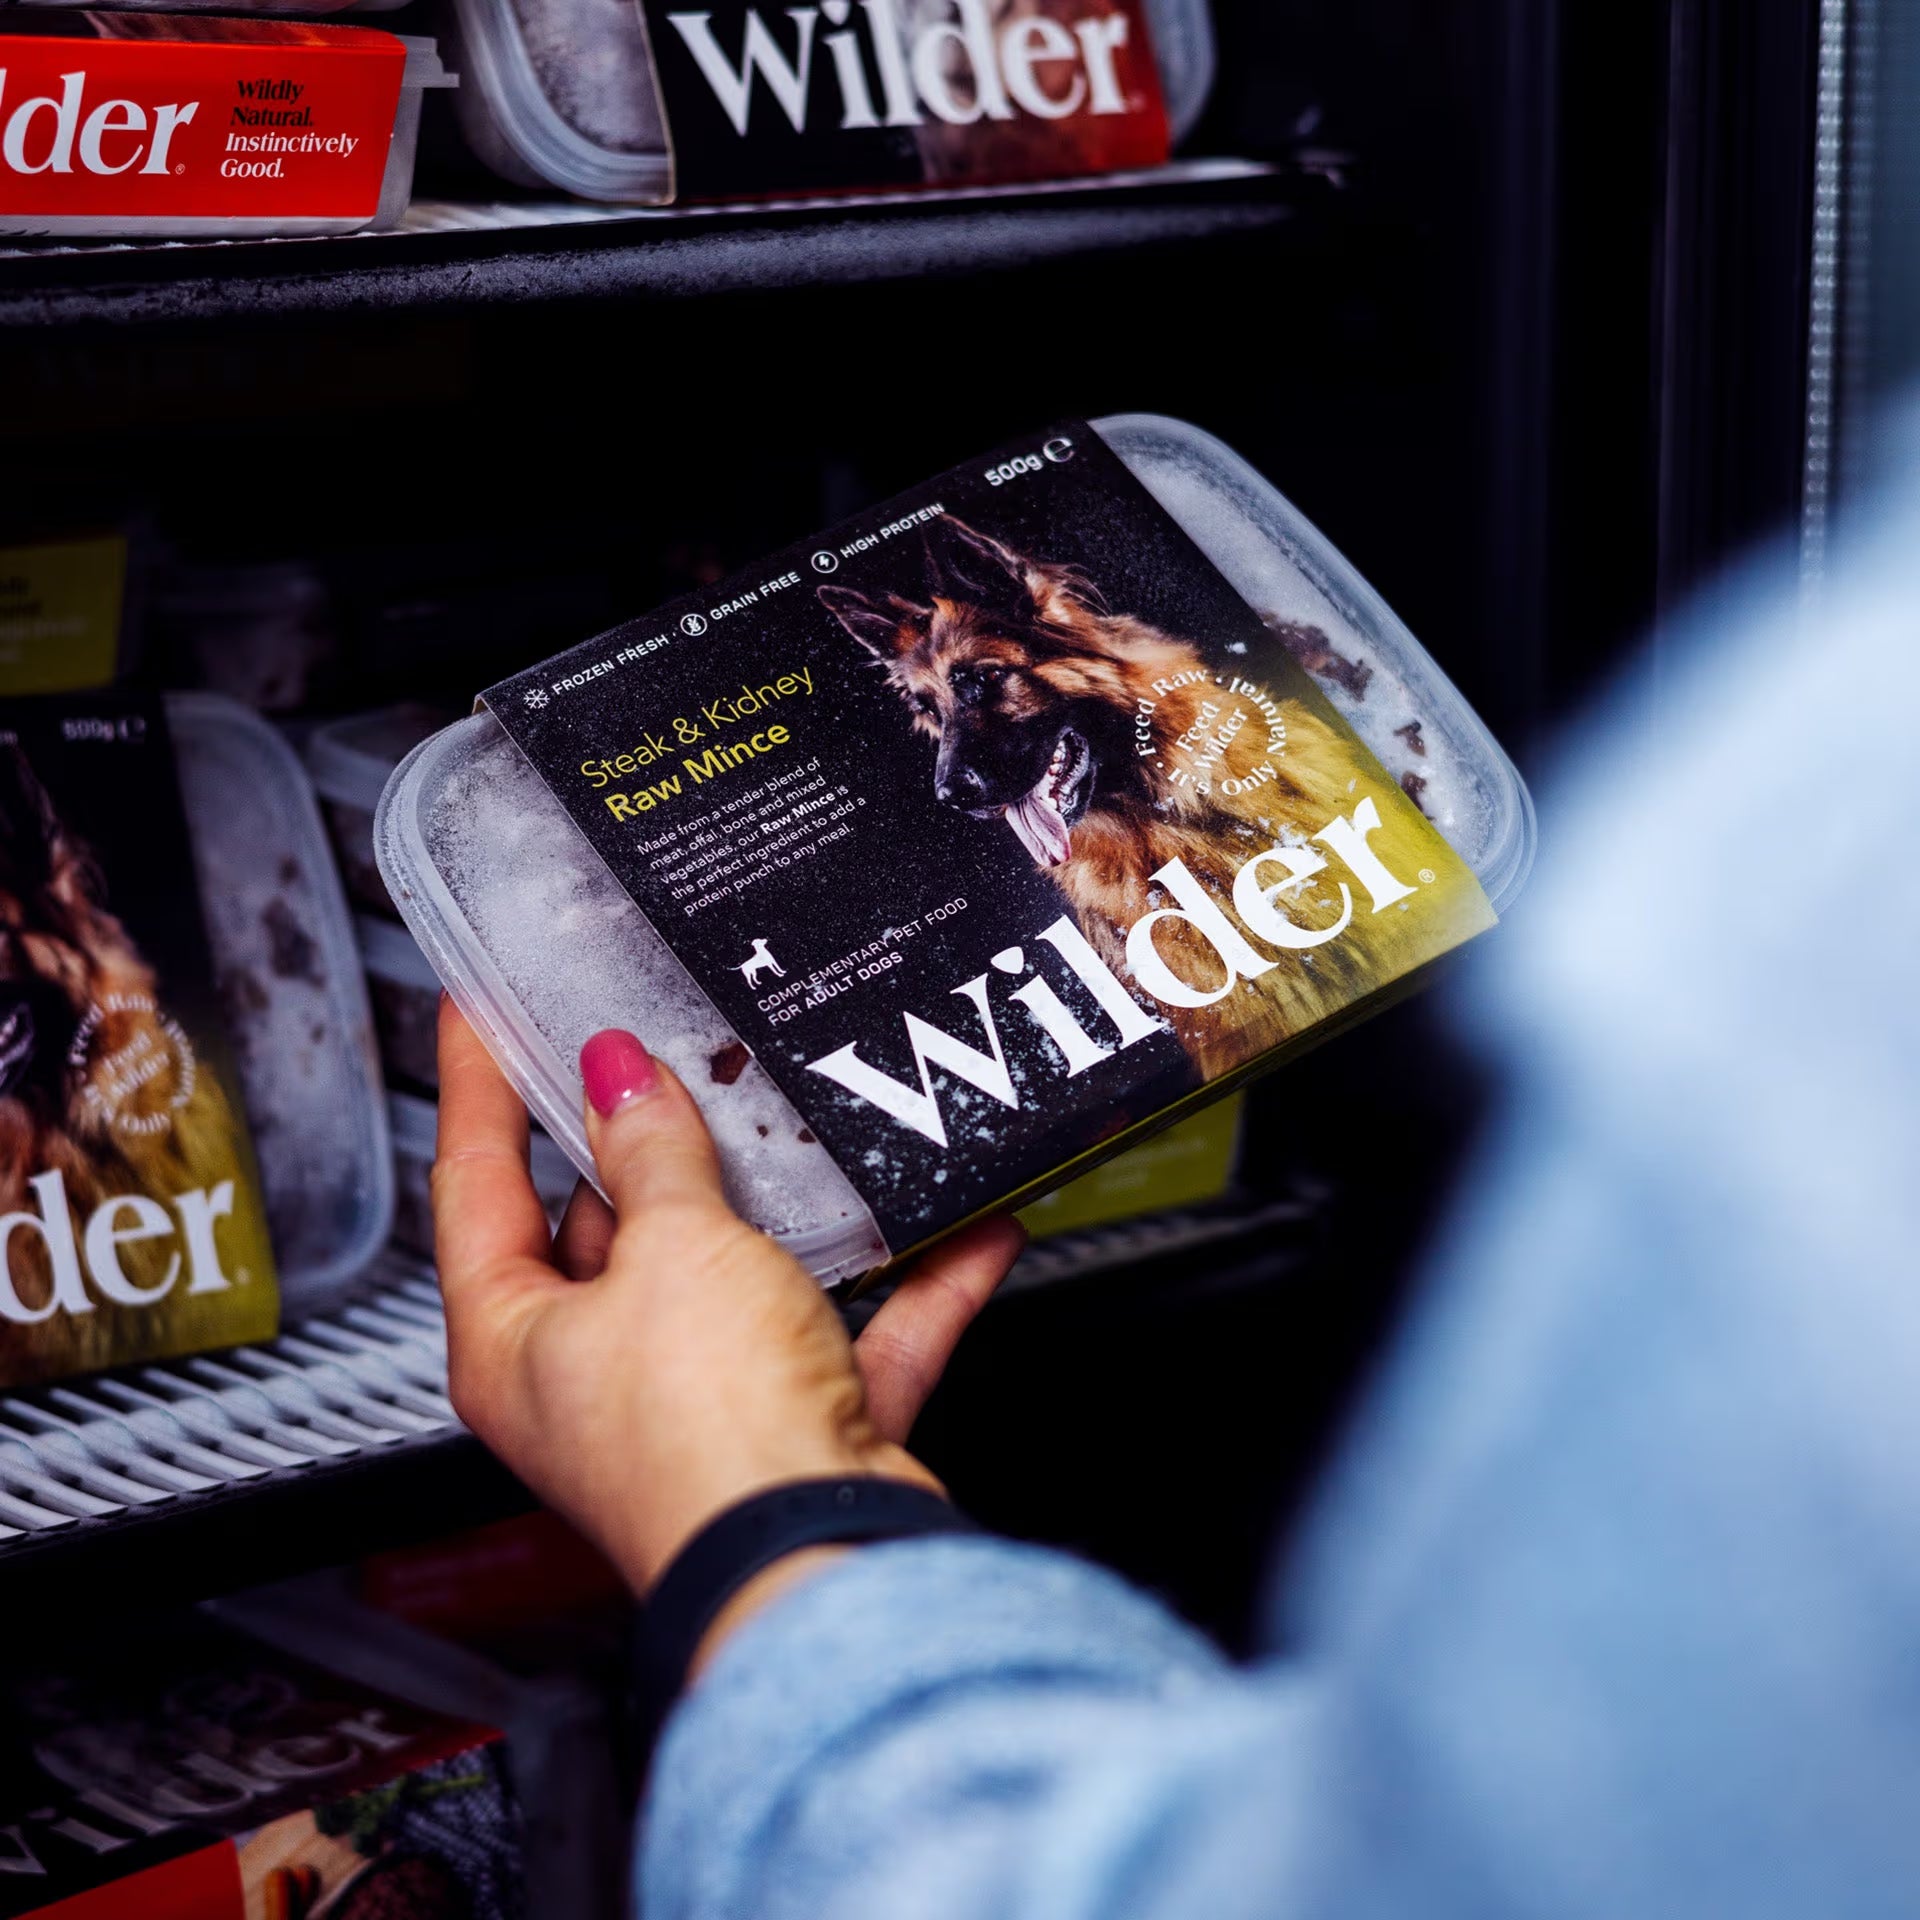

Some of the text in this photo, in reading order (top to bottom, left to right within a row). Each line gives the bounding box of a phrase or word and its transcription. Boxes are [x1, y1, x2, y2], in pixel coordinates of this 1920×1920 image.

[0, 67, 200, 175] der
[230, 106, 314, 127] Natural.
[237, 79, 305, 105] Wildly
[220, 158, 285, 178] Good.
[225, 131, 360, 158] Instinctively
[984, 453, 1044, 487] 500g
[839, 502, 945, 559] HIGH PROTEIN
[709, 570, 801, 621] GRAIN FREE
[551, 633, 670, 696] FROZEN FRESH
[580, 666, 814, 788] Steak & Kidney
[1135, 669, 1209, 757] Feed Raw
[1175, 700, 1221, 753] Feed
[1193, 707, 1248, 769] Wilder
[1229, 677, 1287, 758] Natural
[604, 724, 791, 823] Raw Mince
[636, 756, 821, 856] Made from a tender blend of
[1221, 760, 1278, 796] Only
[649, 774, 827, 871] meat, offal, bone and mixed
[660, 784, 849, 885] vegetables, our Raw Mince is
[671, 796, 867, 901] the perfect ingredient to add a
[683, 822, 855, 917] protein punch to any meal.
[757, 897, 968, 1013] COMPLEMENTARY PET FOOD
[768, 951, 904, 1027] FOR ADULT DOGS
